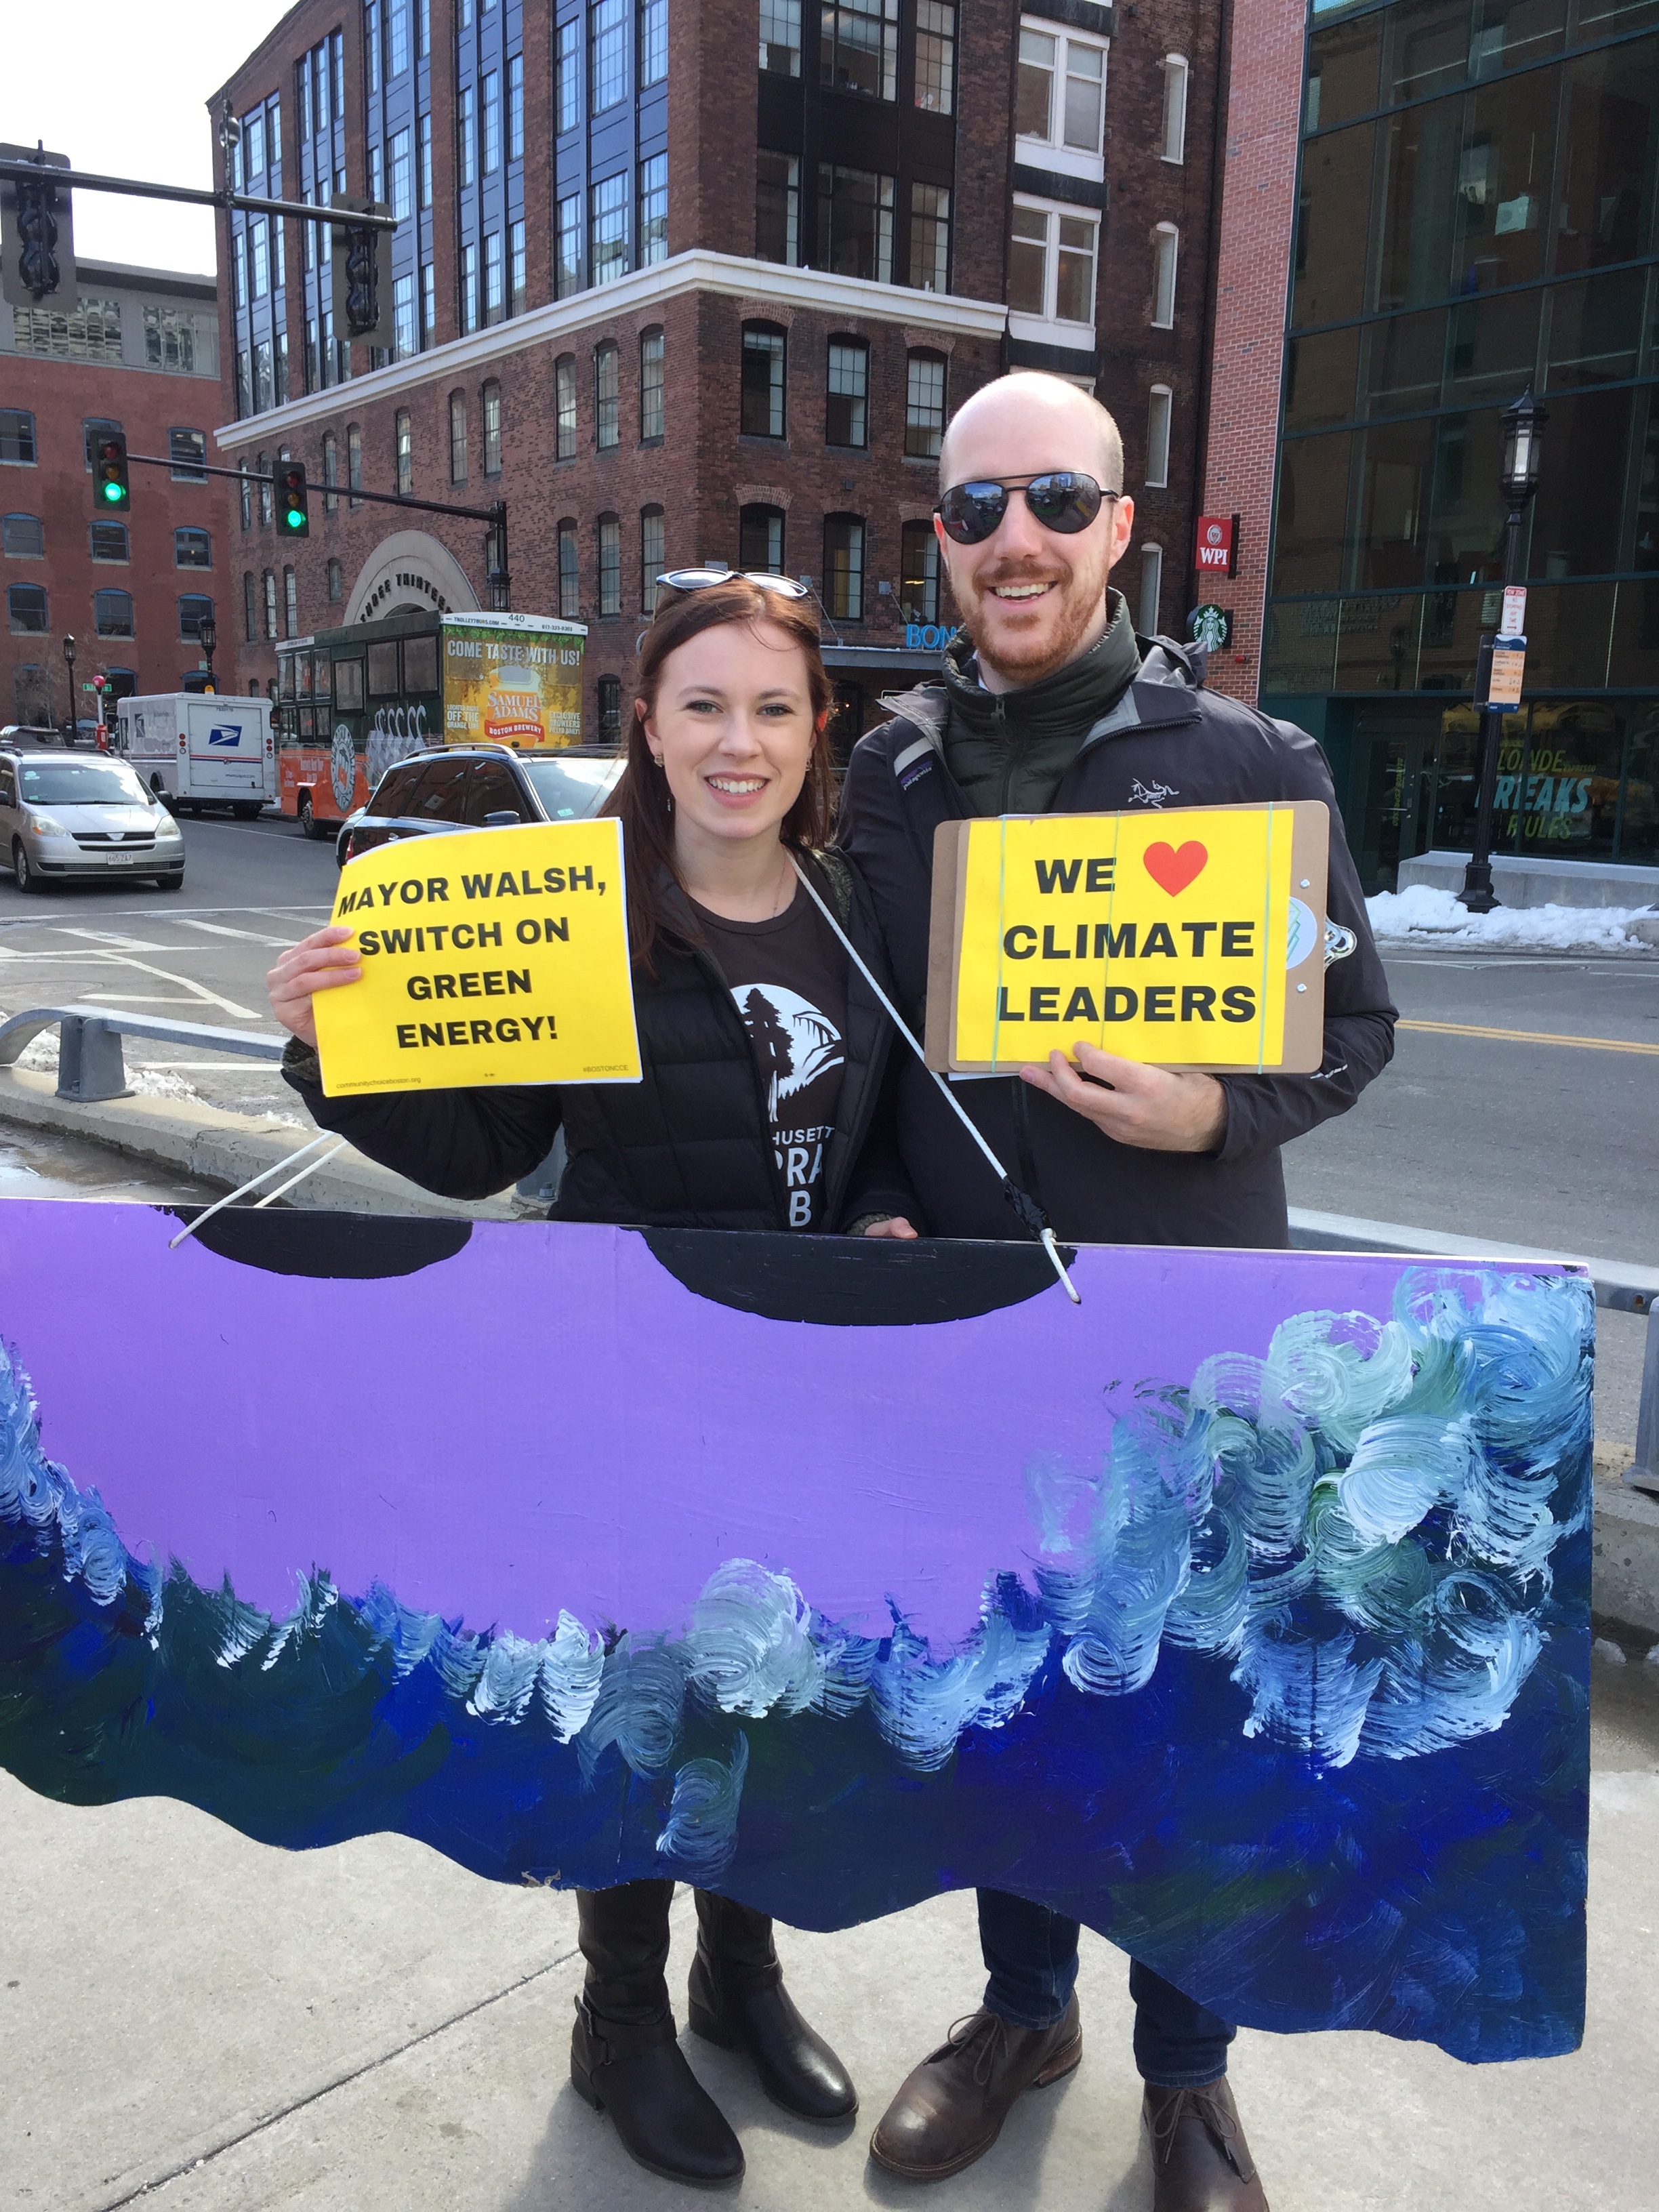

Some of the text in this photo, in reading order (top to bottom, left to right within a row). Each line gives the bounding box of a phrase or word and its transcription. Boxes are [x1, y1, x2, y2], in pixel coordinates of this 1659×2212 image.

[1200, 547, 1228, 565] WPI
[508, 614, 525, 623] 440
[447, 640, 581, 666] COME TASTE WITH US!
[487, 691, 541, 709] SAMUEL
[447, 710, 479, 722] OFF THE
[492, 705, 538, 722] ADAMS
[549, 711, 581, 720] EXCLUSIVE
[489, 723, 541, 736] BOSTON BREWERY
[549, 720, 581, 729] GROWLERS
[1035, 858, 1116, 894] WE
[337, 865, 607, 918] MAYOR WALSH,
[359, 917, 569, 956] SWITCH ON
[1003, 922, 1255, 960] CLIMATE
[407, 969, 532, 1000] GREEN
[998, 985, 1256, 1023] LEADERS
[396, 1016, 558, 1048] ENERGY!
[336, 1077, 421, 1088] communitychoiceboston.org
